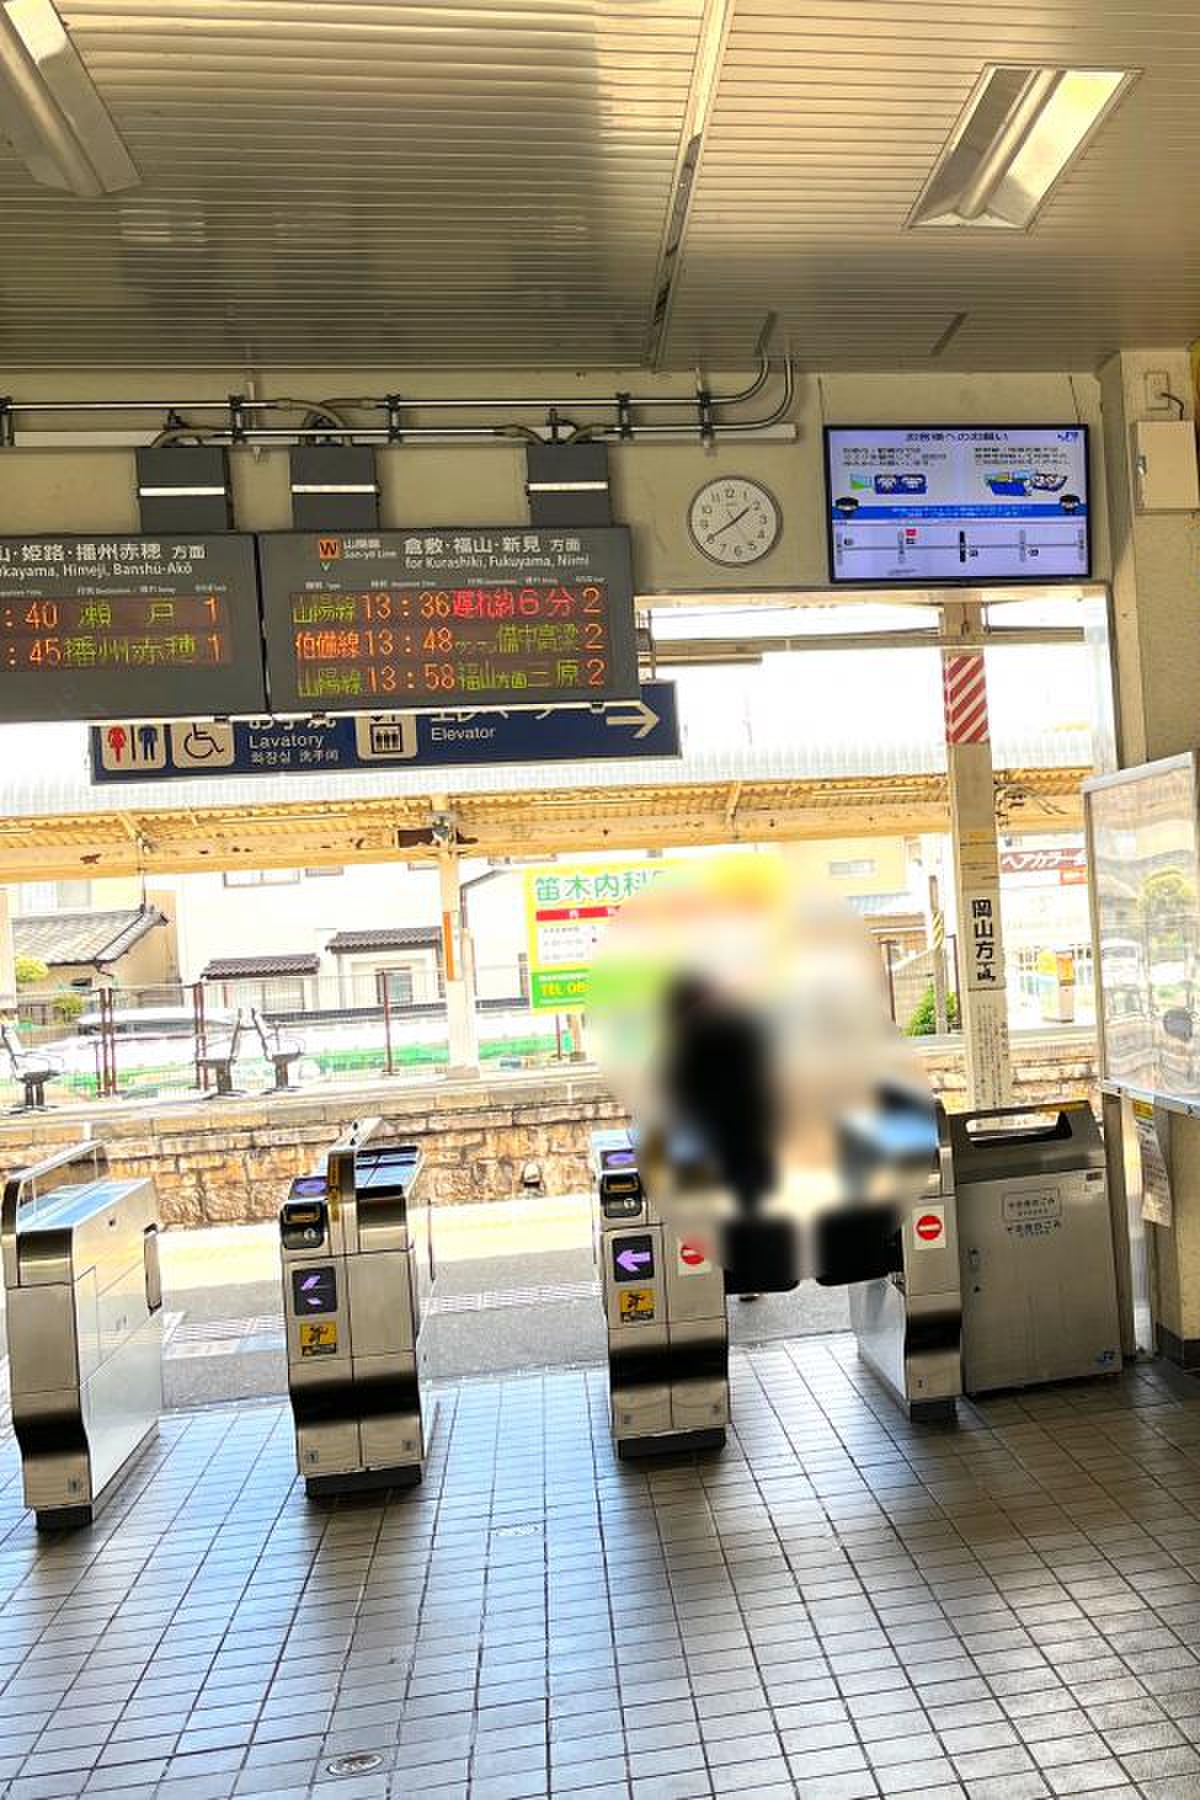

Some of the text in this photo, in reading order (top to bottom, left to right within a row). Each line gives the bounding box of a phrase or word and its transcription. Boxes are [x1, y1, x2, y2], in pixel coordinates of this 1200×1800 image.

[171, 544, 206, 560] 方面
[549, 537, 581, 553] 方面
[405, 554, 589, 570] for Kurashiki, Fukuyama, Niimi
[0, 563, 60, 581] kayama,
[203, 593, 220, 623] 1
[364, 591, 451, 622] 13:36
[581, 586, 602, 614] 2
[207, 633, 222, 663] 1
[366, 627, 453, 656] 13:48
[583, 623, 604, 650] 2
[368, 662, 456, 692] 13:58
[586, 657, 606, 687] 2
[249, 733, 325, 751] Lavatory
[430, 727, 497, 742] Elevator
